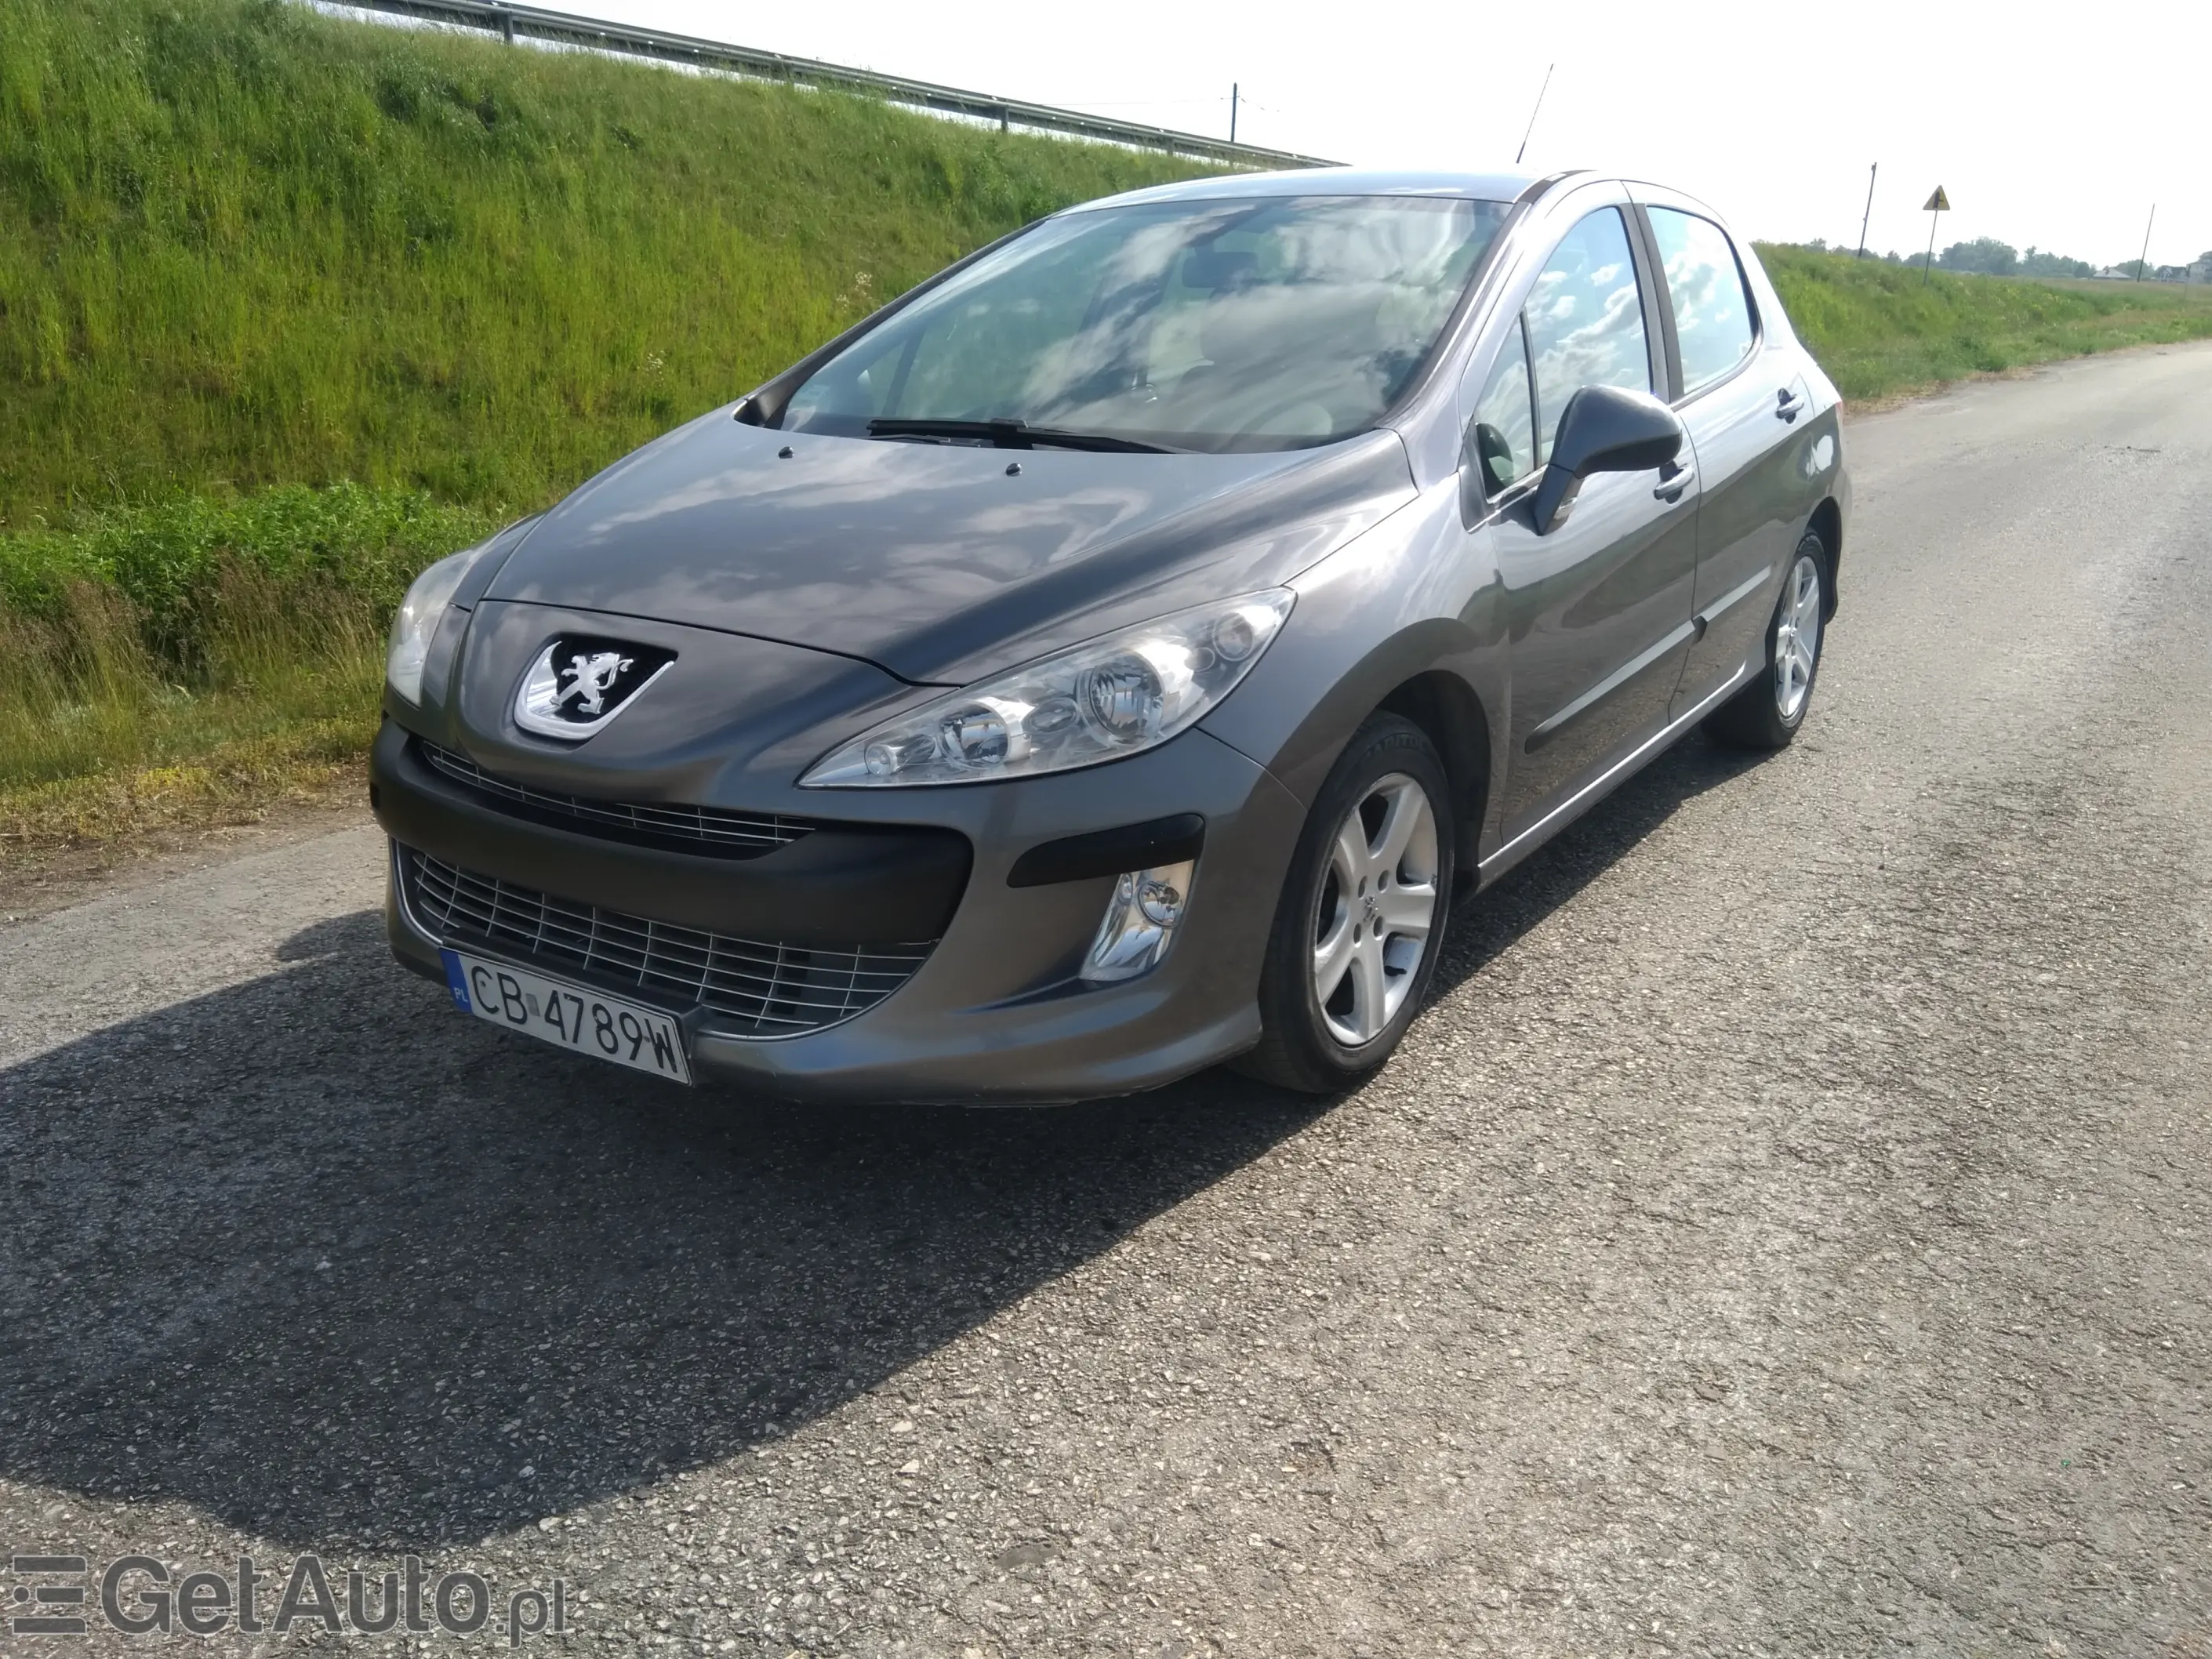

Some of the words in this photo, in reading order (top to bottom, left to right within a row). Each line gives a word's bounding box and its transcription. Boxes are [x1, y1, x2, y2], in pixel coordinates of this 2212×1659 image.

[453, 987, 468, 1002] PL
[471, 966, 528, 1025] CB
[544, 989, 677, 1073] 4789W
